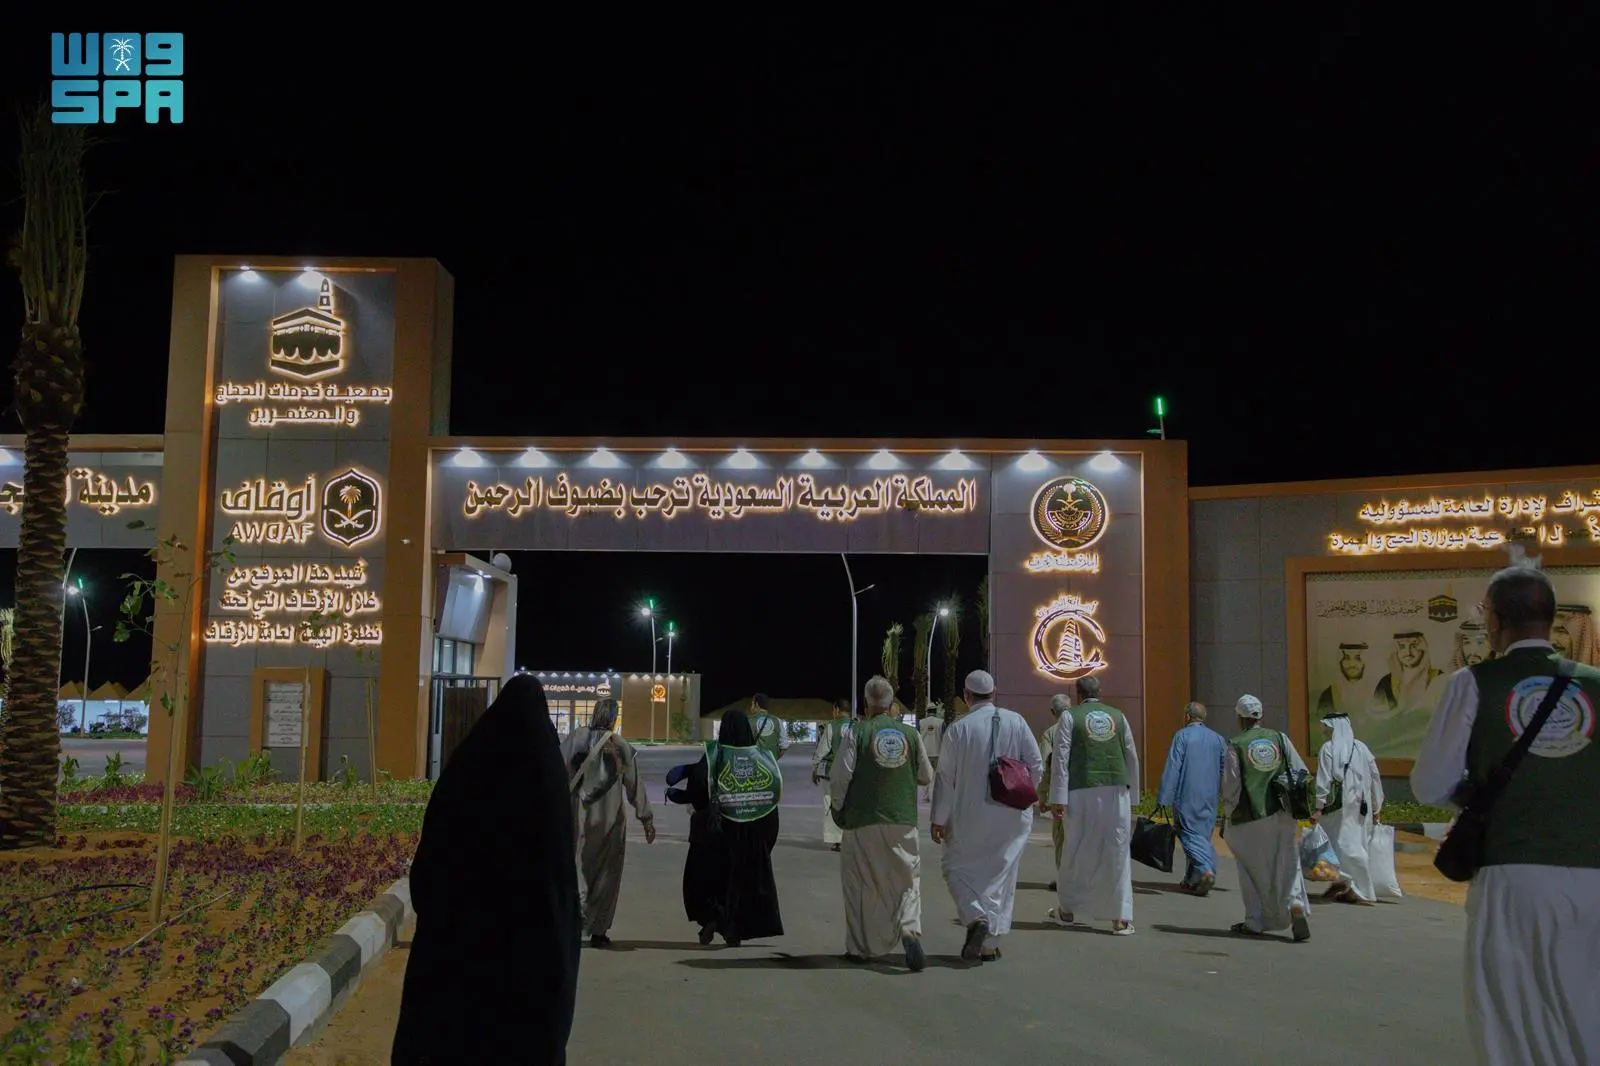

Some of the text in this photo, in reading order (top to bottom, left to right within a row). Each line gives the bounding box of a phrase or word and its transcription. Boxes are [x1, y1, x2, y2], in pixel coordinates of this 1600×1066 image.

[216, 381, 393, 404] جمعية خدمات الحجاج
[248, 406, 359, 426] والمعتمرين
[72, 467, 154, 515] مدينة
[221, 474, 316, 522] أوقاف
[464, 472, 977, 520] المملكة العربية السعودية ترحب بضيوف الرحمن
[232, 521, 315, 543] AWQAF
[1386, 527, 1419, 551] الحج
[1420, 526, 1467, 548] بوزارة
[227, 565, 250, 588] من
[250, 563, 304, 589] الموقع
[305, 563, 333, 585] هذا
[252, 589, 285, 620] التي
[285, 587, 344, 615] الأوقاف
[343, 590, 381, 616] خلال
[204, 620, 258, 647] للأوقاف
[258, 621, 297, 643] العامة
